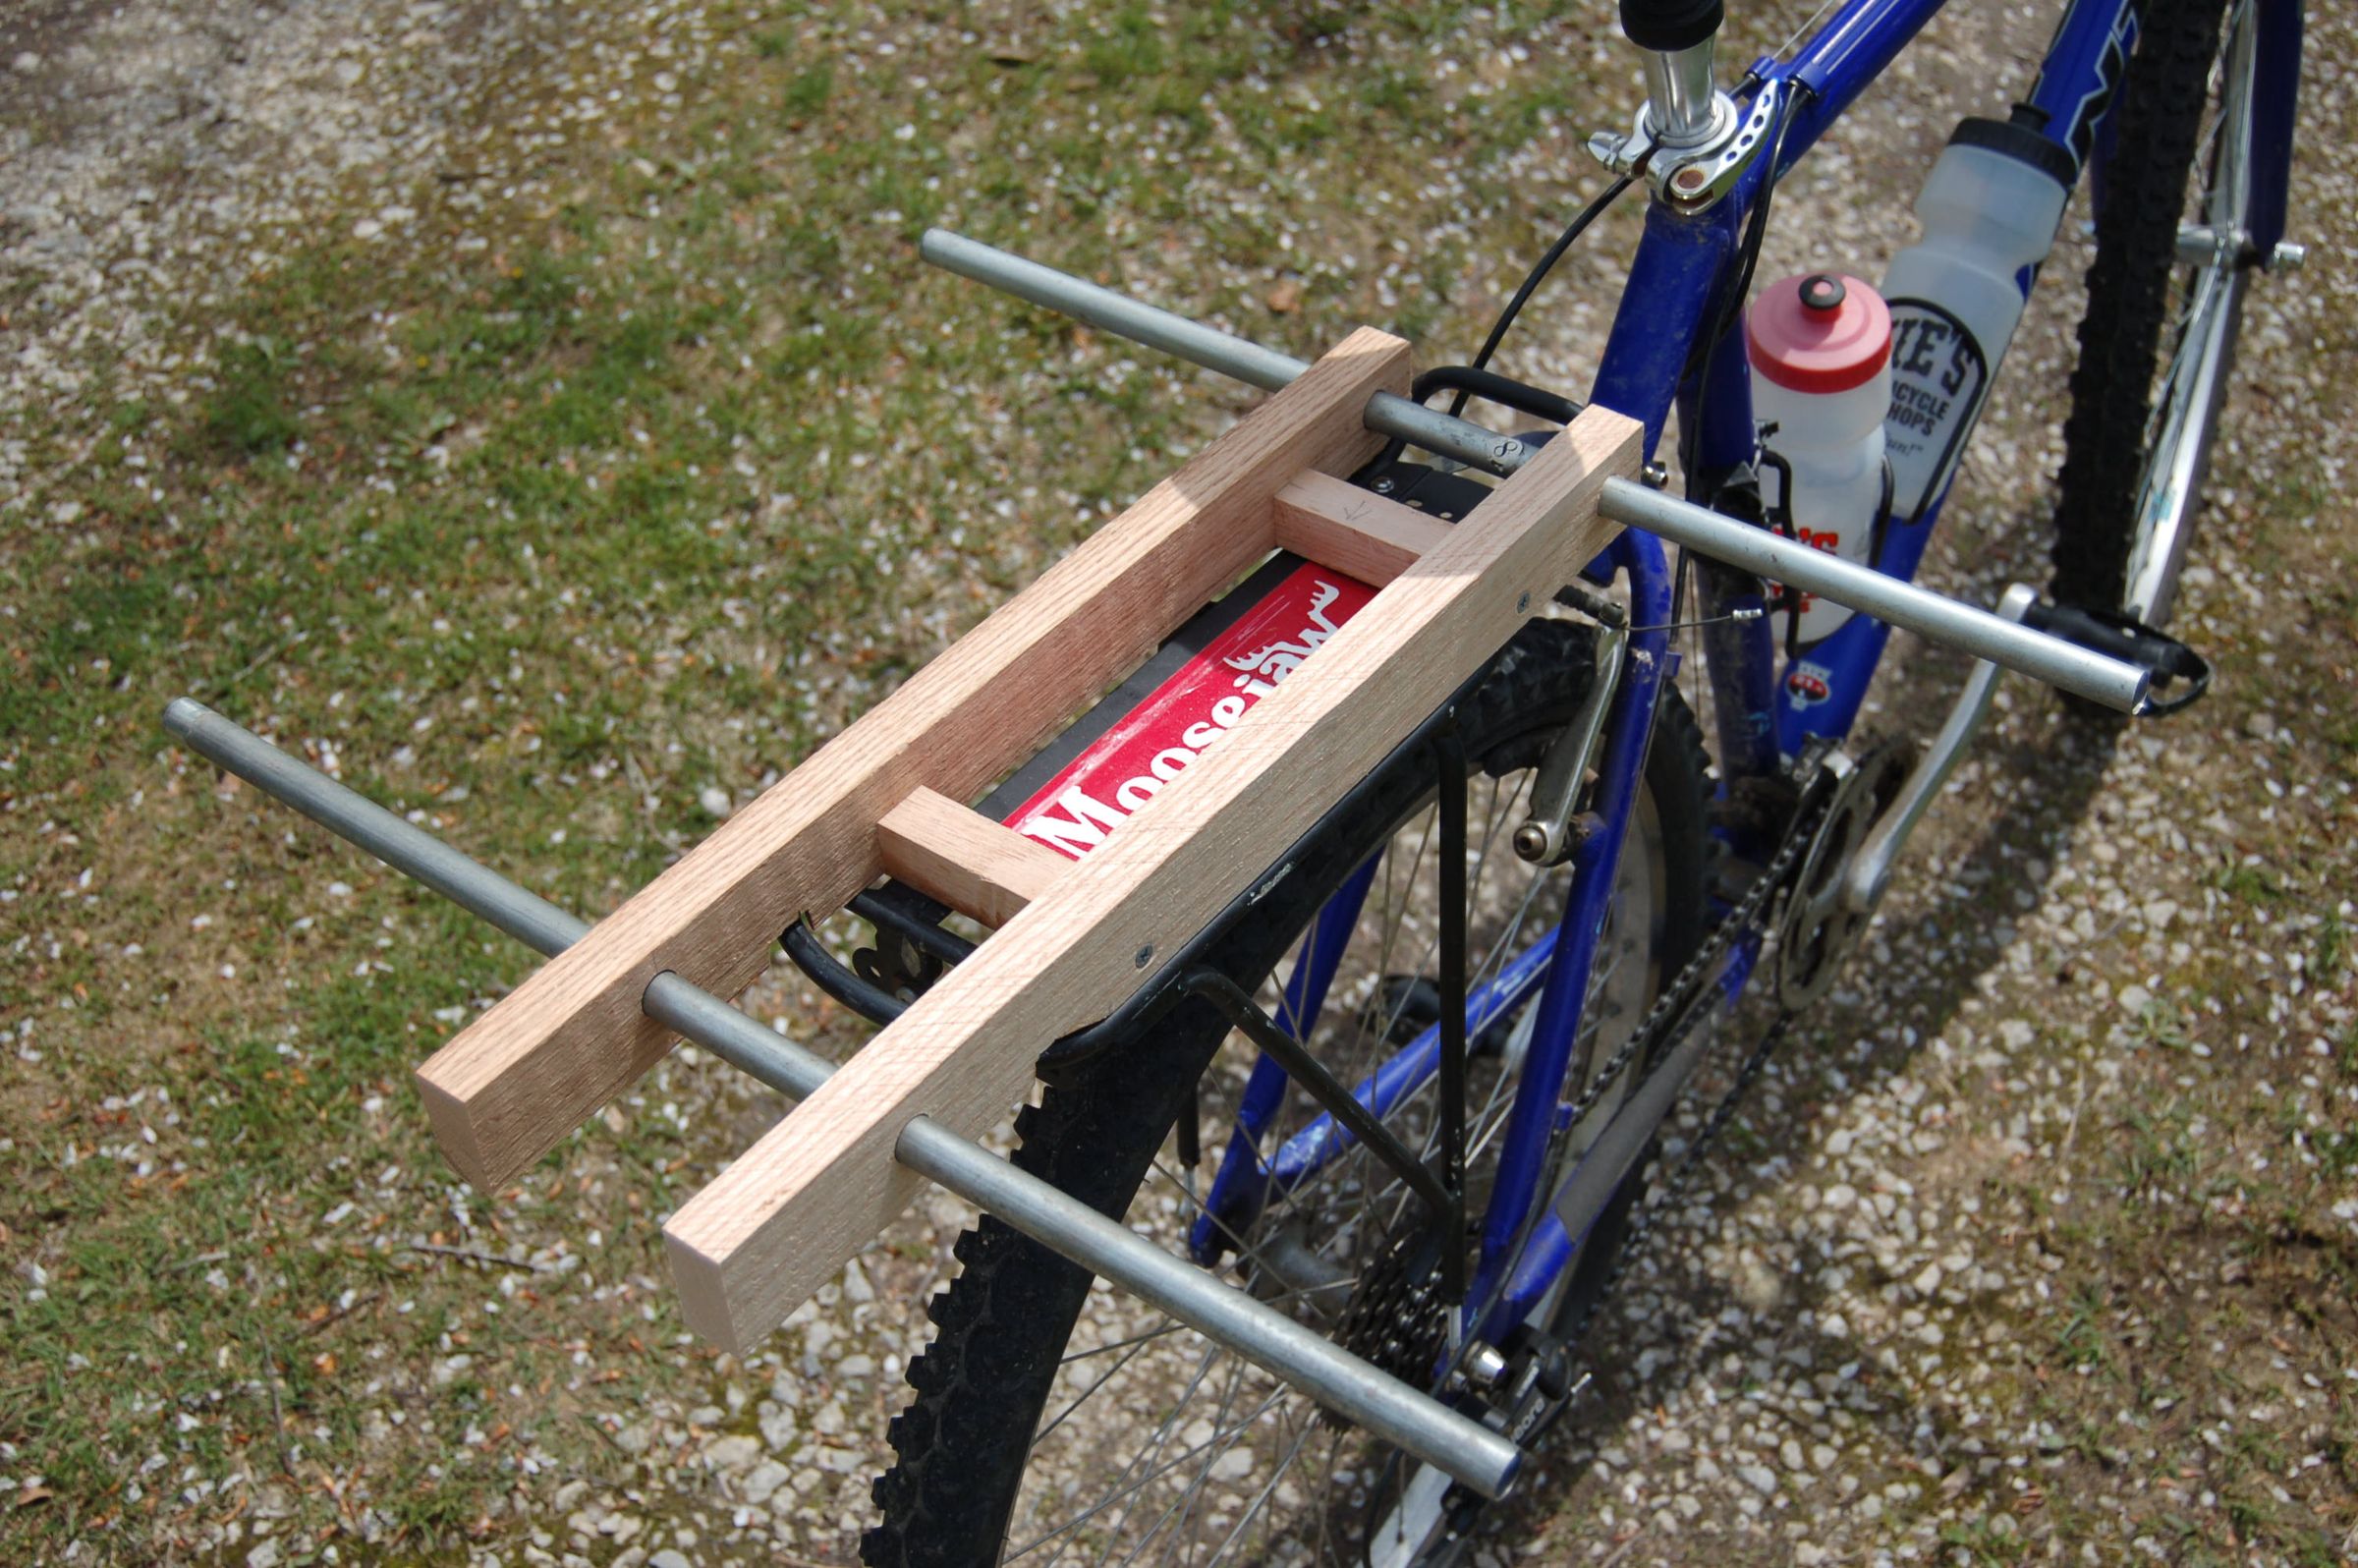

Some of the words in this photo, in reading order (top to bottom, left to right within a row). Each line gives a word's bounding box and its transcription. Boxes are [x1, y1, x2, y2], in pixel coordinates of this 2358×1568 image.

[1892, 319, 1974, 397] IE'S
[1886, 402, 1936, 436] HOPS
[1892, 380, 1949, 420] ICYCLE
[1511, 1396, 1545, 1445] eore
